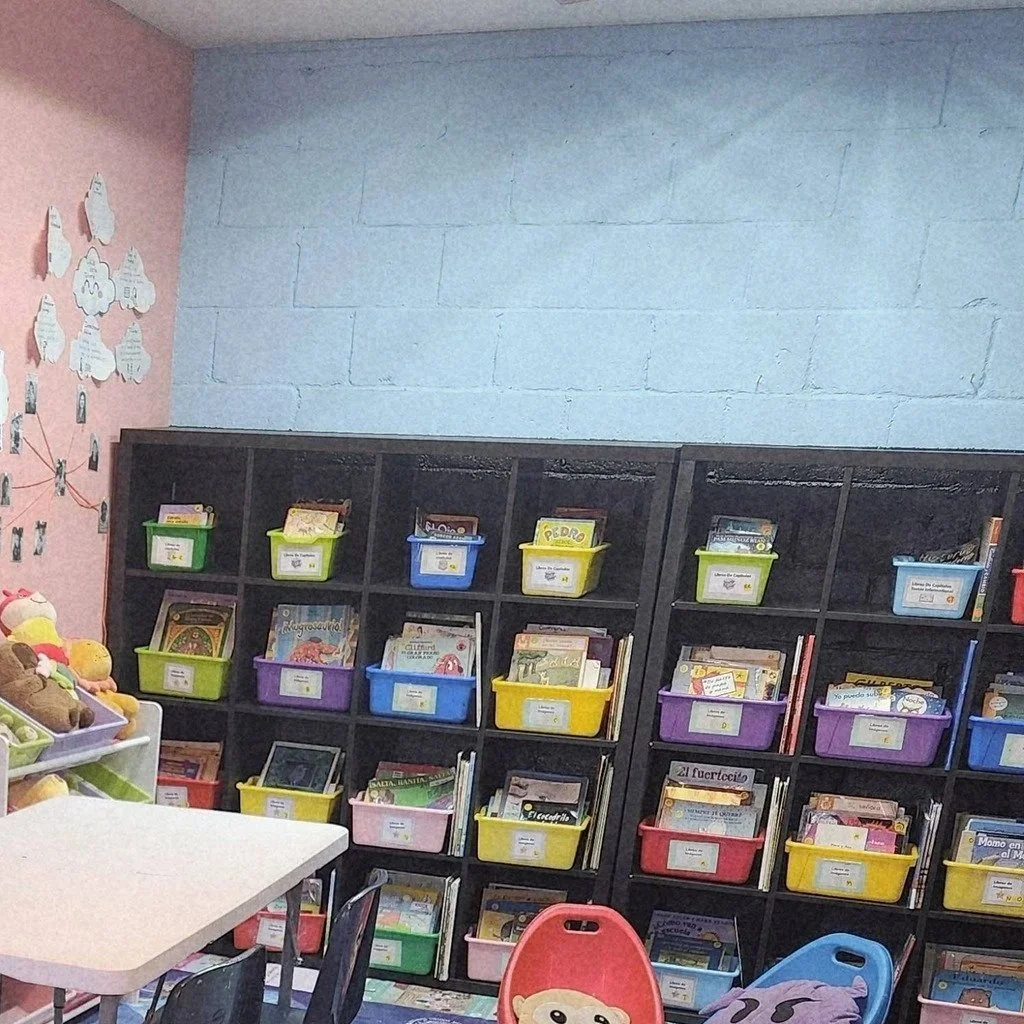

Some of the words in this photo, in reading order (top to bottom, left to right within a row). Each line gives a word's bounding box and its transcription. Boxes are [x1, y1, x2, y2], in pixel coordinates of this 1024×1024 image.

[543, 525, 586, 543] PEDRO
[404, 643, 436, 651] Clifford
[692, 767, 749, 784] fuertecito
[536, 813, 570, 822] cocodrilo
[977, 836, 1007, 848] Momo
[1008, 841, 1022, 850] en
[1001, 849, 1011, 859] el
